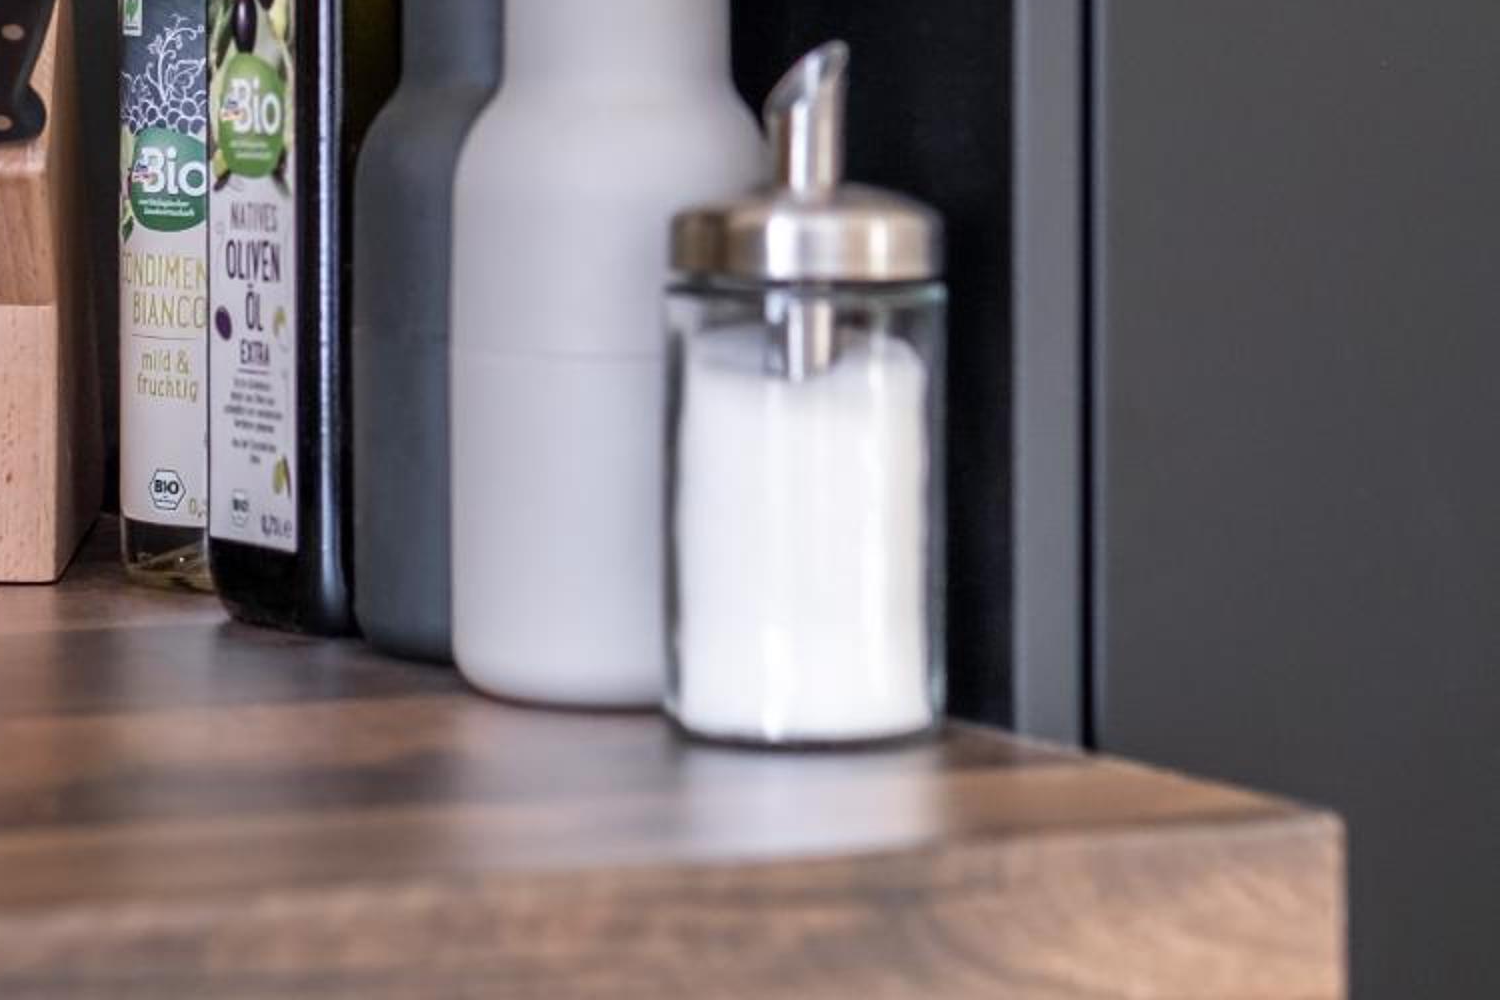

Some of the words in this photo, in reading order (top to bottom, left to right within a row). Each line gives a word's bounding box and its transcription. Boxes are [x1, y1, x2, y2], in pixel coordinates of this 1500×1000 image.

[230, 76, 282, 136] Bio
[141, 146, 207, 197] Bio
[230, 202, 278, 232] NATIVES
[226, 239, 281, 283] OLIVEN
[132, 291, 207, 328] BIANCO
[141, 350, 171, 373] mild
[175, 350, 190, 375] &
[239, 338, 271, 367] EXTRA
[136, 372, 198, 403] fruchtig
[153, 479, 180, 495] BIO
